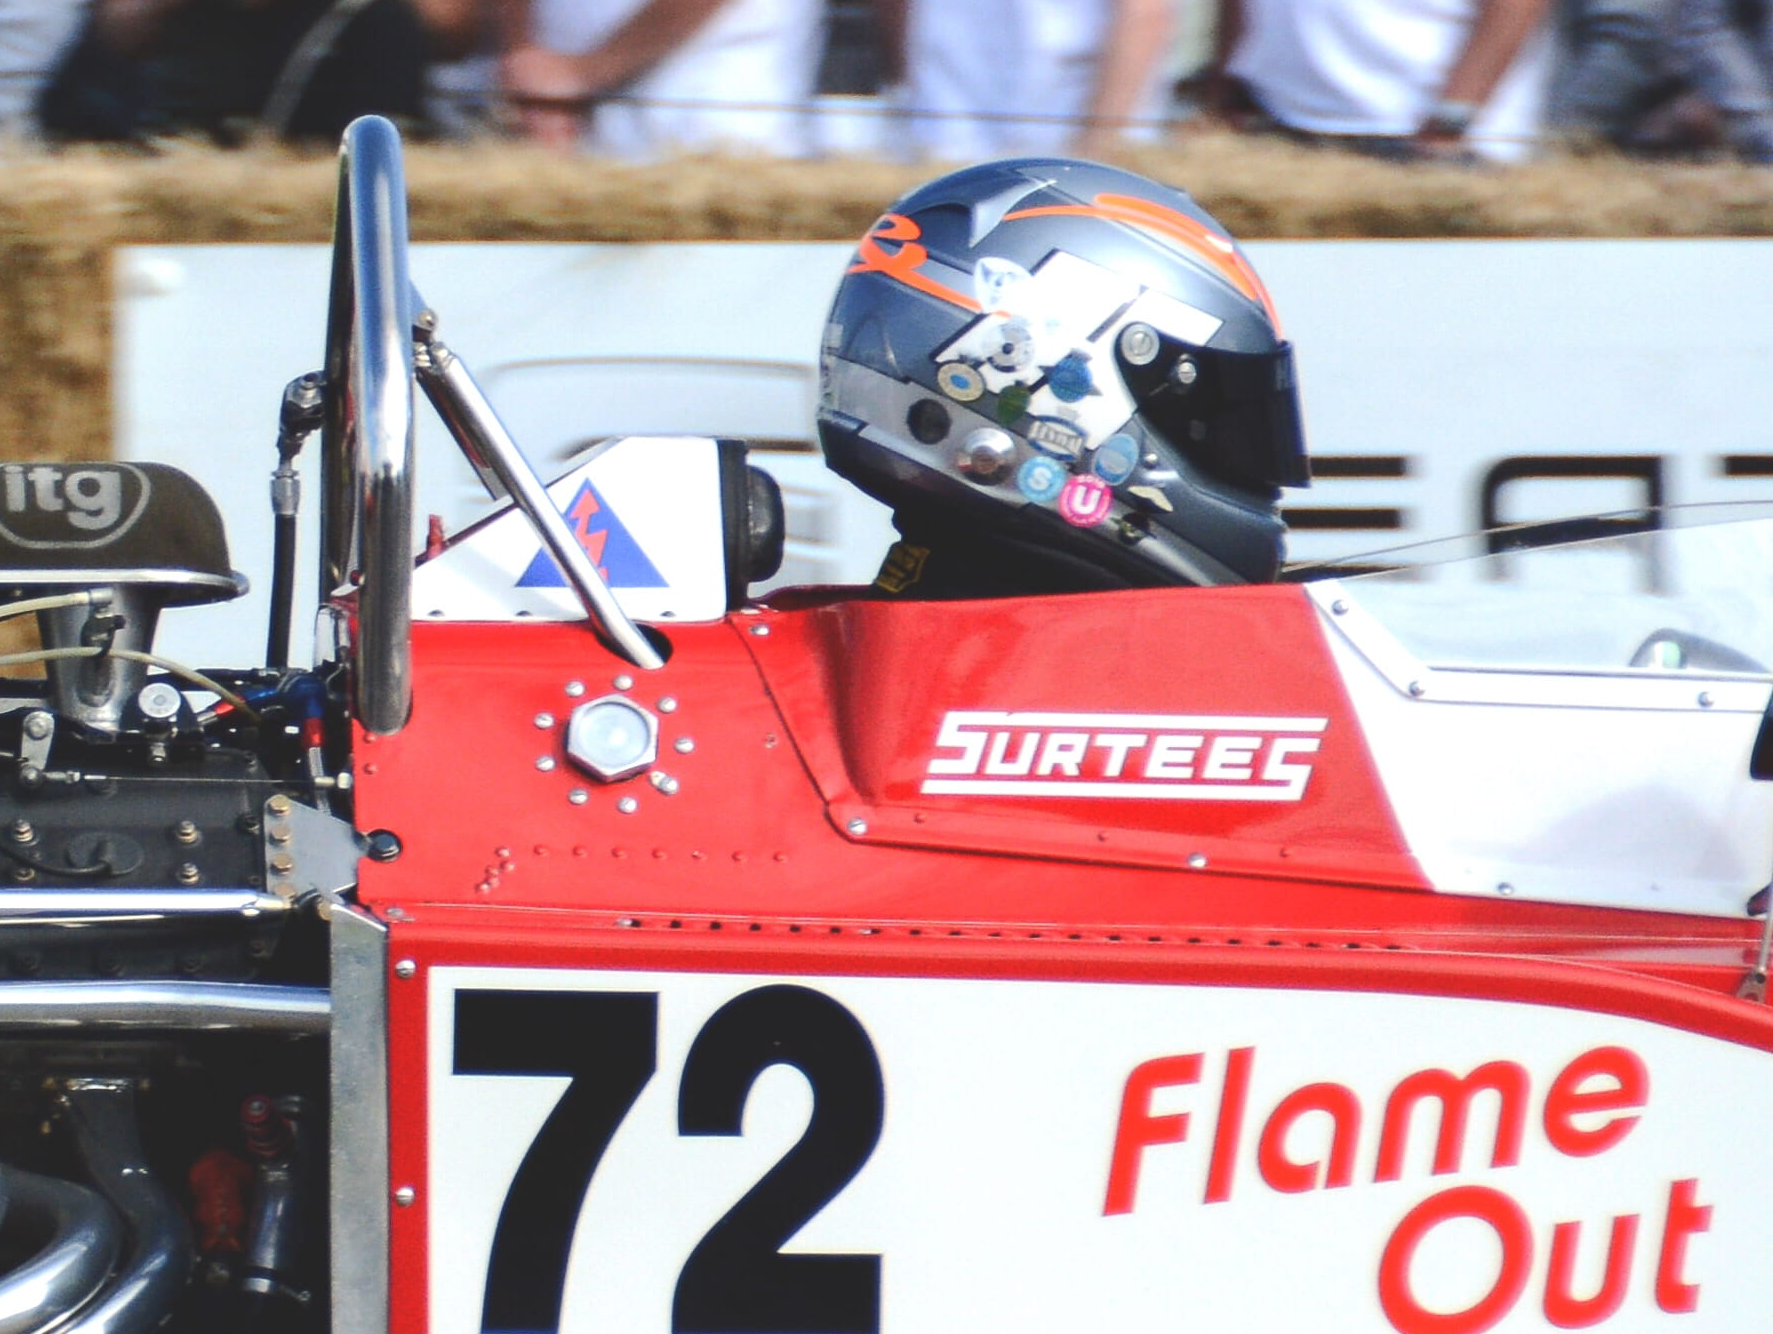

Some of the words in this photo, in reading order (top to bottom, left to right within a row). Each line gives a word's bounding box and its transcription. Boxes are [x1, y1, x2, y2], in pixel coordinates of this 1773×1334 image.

[4, 465, 121, 530] itg
[920, 711, 1329, 801] SURTEES
[1101, 1045, 1651, 1217] Flame
